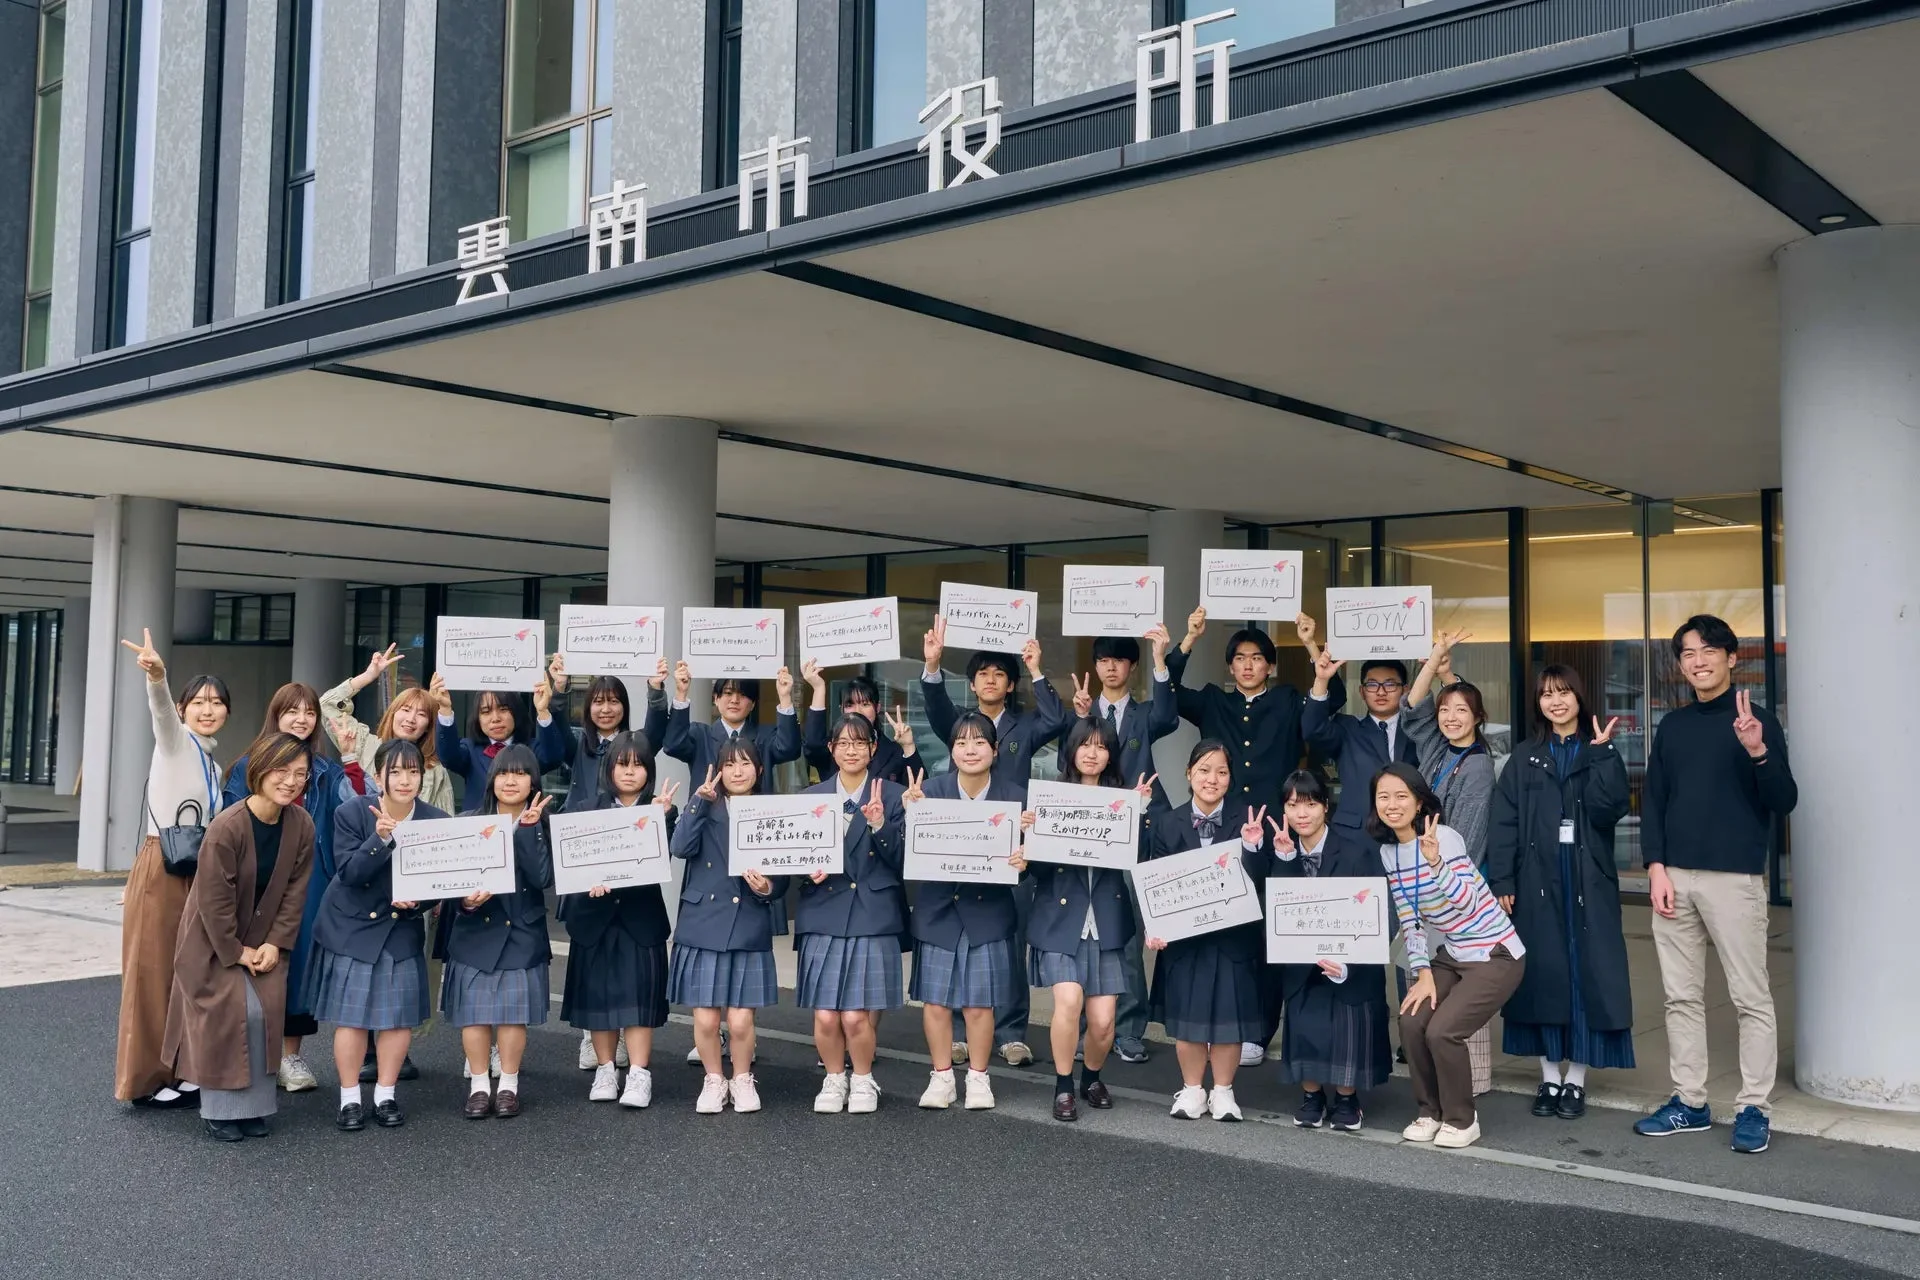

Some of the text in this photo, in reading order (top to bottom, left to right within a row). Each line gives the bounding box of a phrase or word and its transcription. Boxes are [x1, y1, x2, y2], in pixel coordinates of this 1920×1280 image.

[456, 8, 1238, 305] 雲南市役所
[1351, 612, 1408, 632] JOYN
[457, 648, 517, 660] HAPPINESS
[756, 819, 794, 830] 高齢者の
[746, 830, 824, 843] 日常の楽しみを増やす
[1669, 1113, 1689, 1129] N
